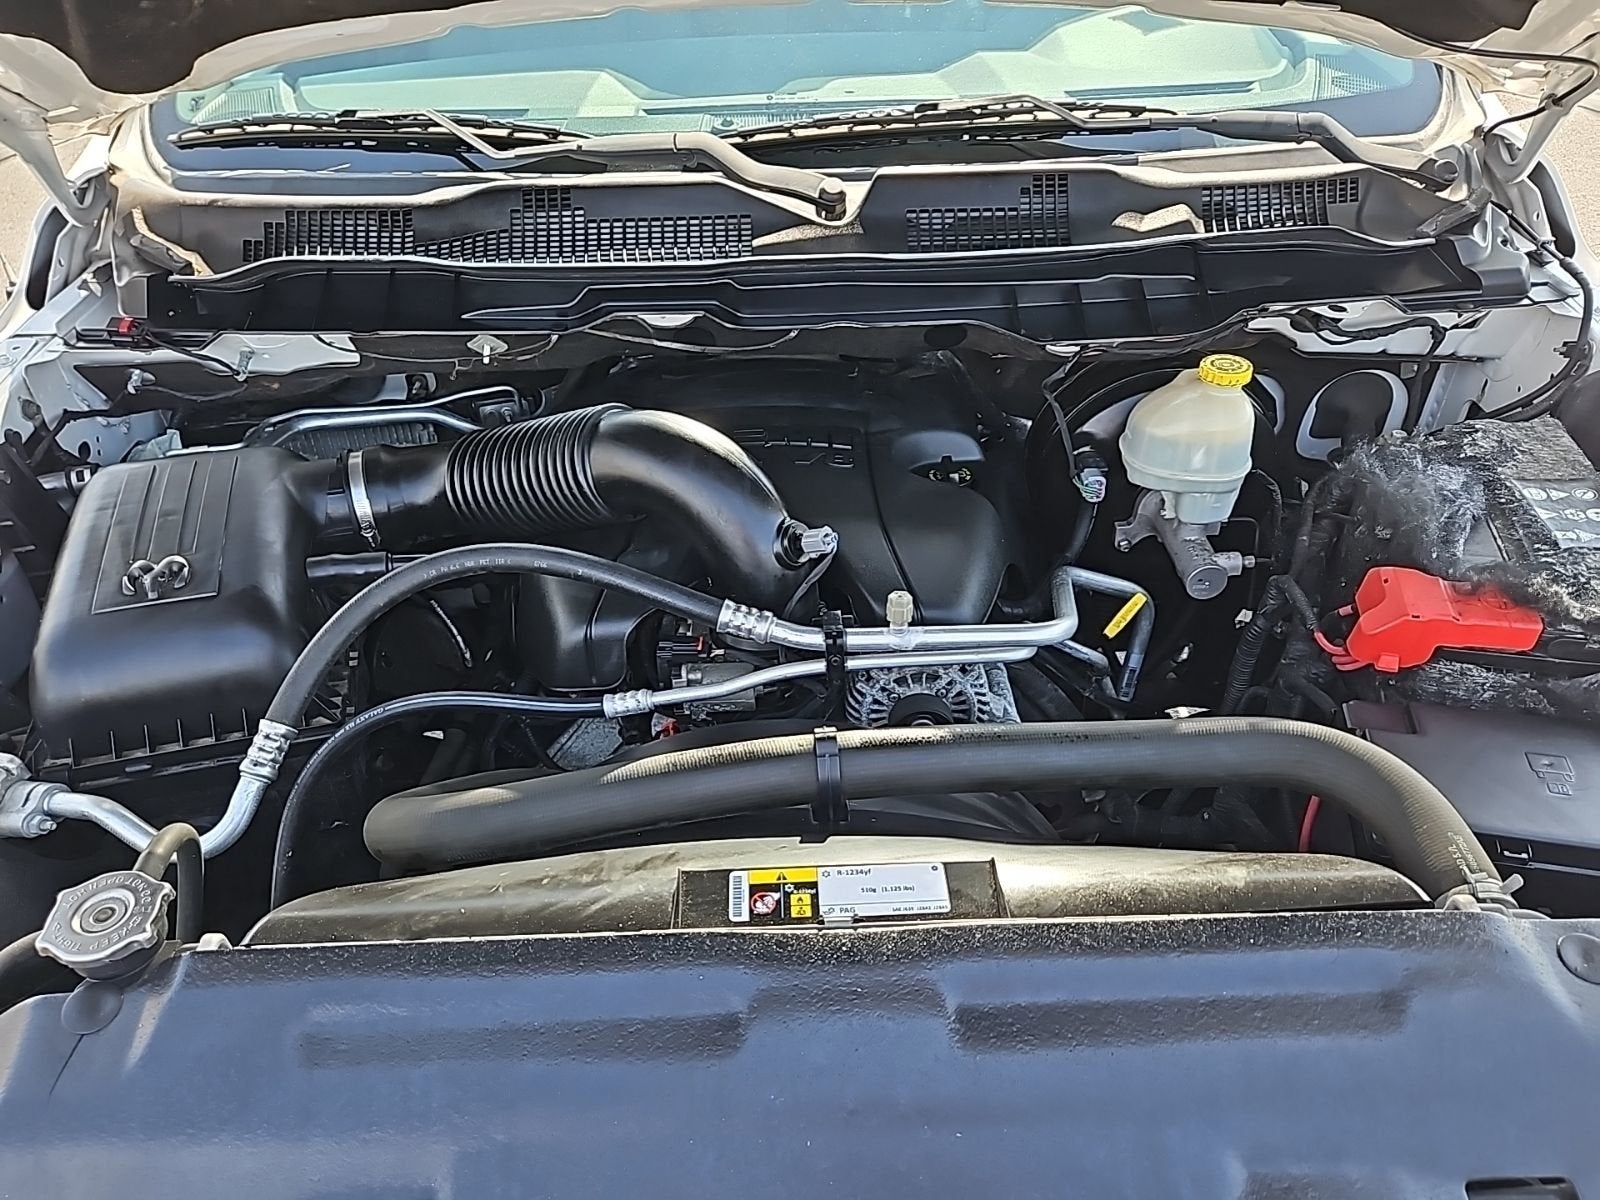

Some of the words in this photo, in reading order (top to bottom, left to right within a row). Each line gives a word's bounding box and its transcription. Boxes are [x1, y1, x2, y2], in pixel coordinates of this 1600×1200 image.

[355, 707, 384, 725] GALAXY
[836, 868, 872, 876] R-1234yf
[53, 922, 82, 952] TIGHT
[89, 927, 129, 950] KEEP
